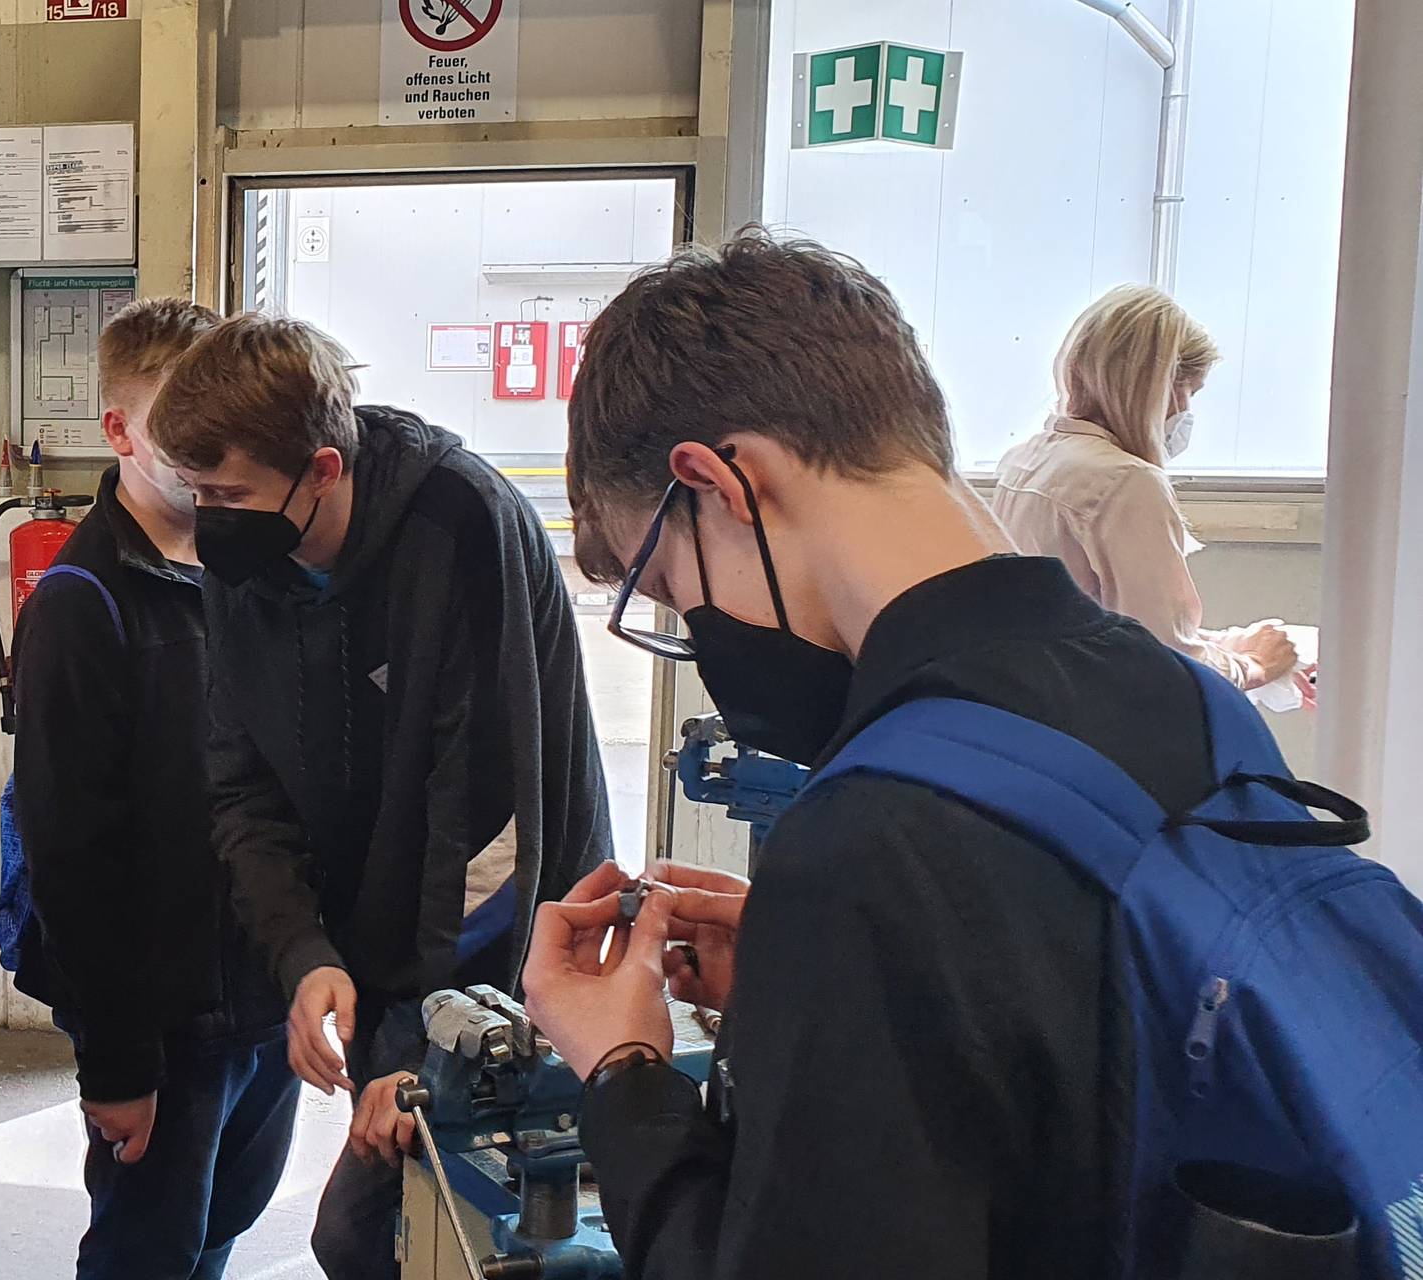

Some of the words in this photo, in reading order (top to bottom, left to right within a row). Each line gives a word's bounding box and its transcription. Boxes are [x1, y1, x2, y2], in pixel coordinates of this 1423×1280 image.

[47, 5, 64, 20] 15
[93, 2, 119, 18] /18
[428, 55, 468, 69] Feuer,
[406, 72, 454, 86] offenes
[458, 70, 491, 84] Licht
[405, 90, 429, 103] und
[432, 88, 490, 102] Rauchen
[418, 106, 475, 120] verboten
[54, 279, 67, 287] und
